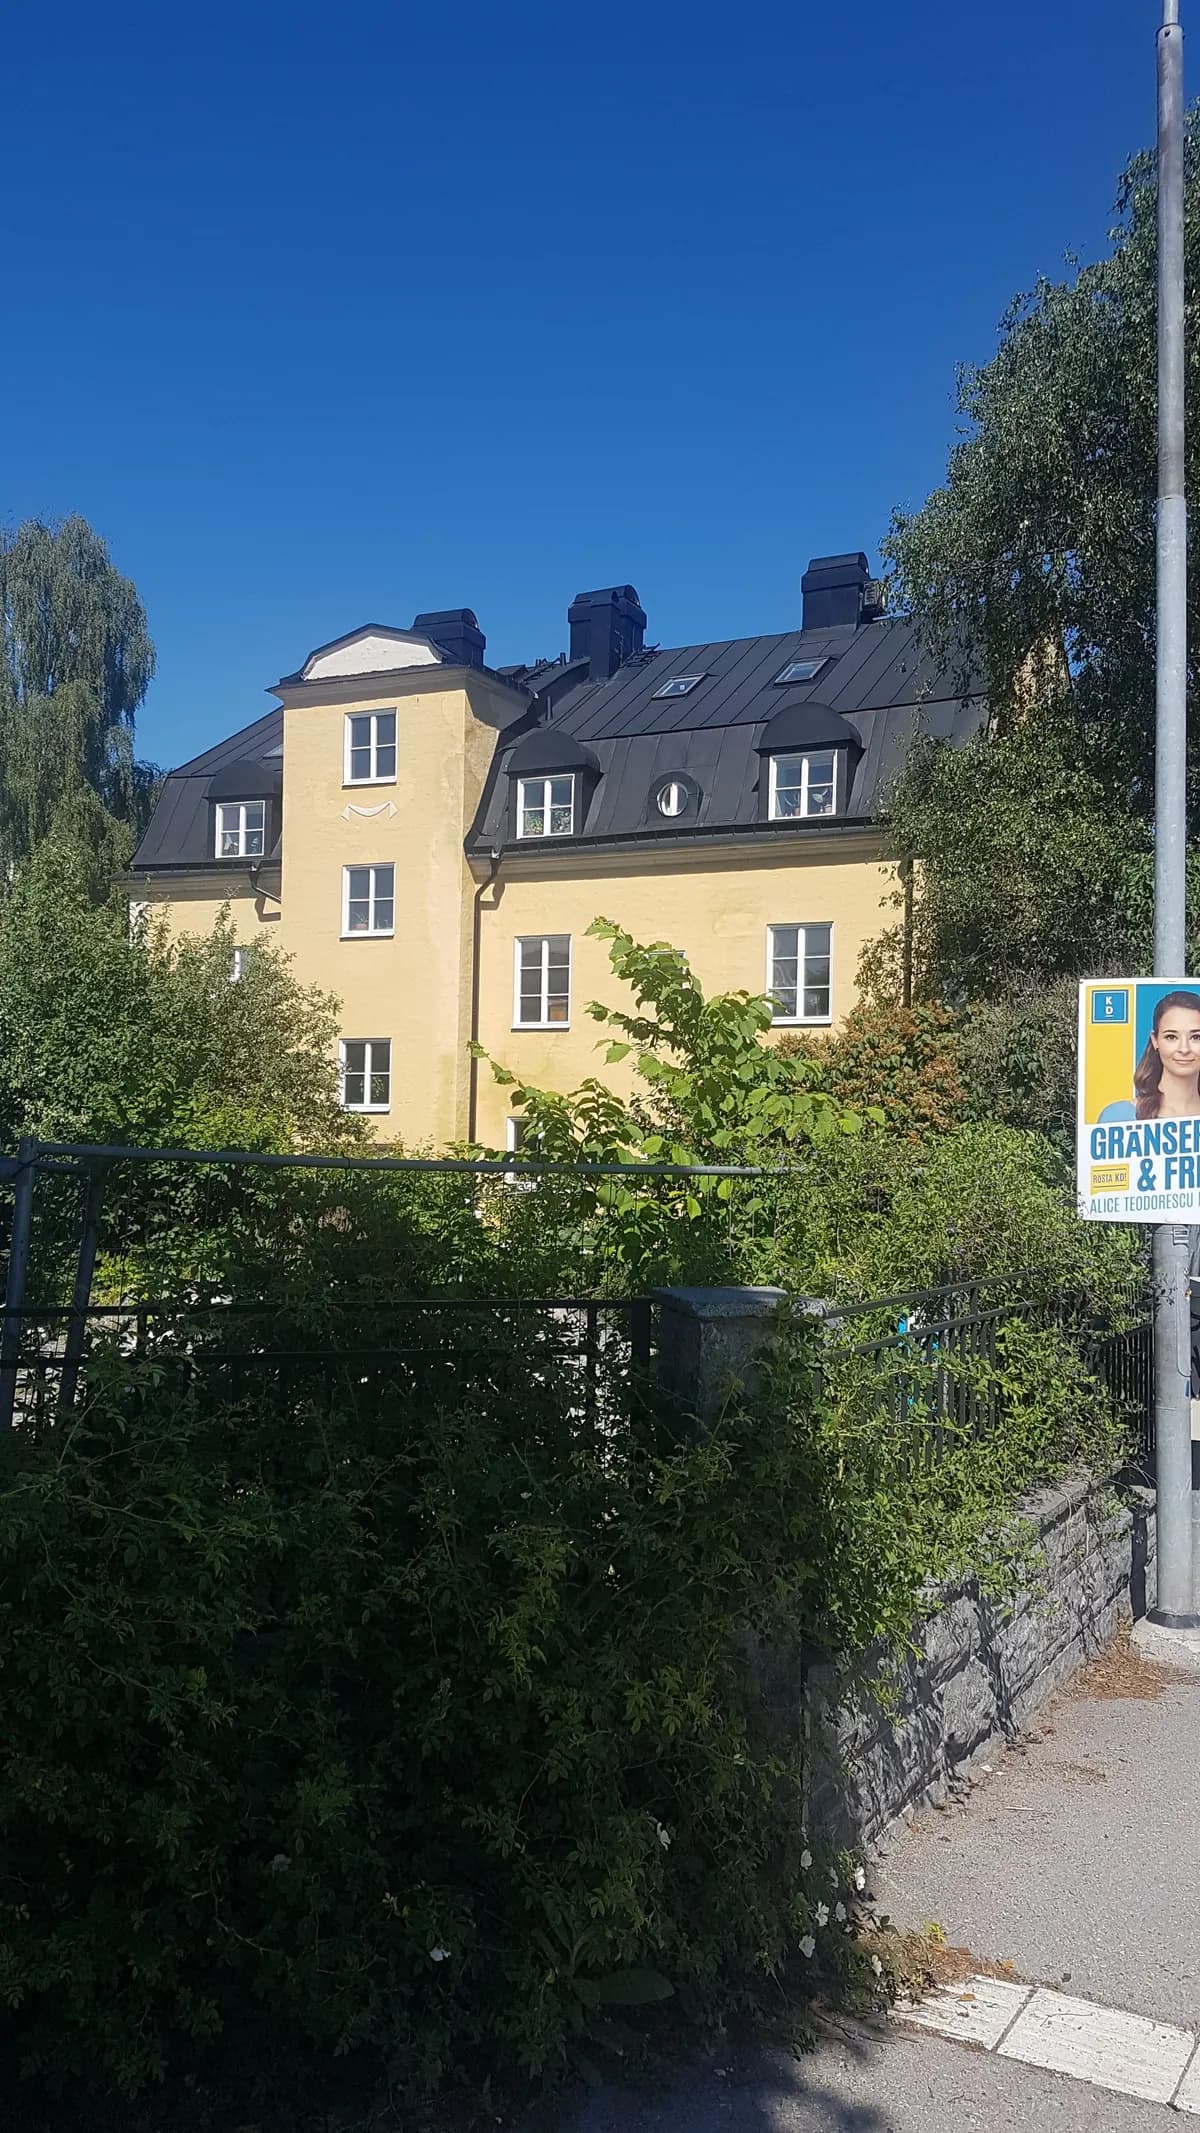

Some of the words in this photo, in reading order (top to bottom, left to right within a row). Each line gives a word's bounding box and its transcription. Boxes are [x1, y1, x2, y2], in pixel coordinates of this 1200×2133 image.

[1137, 1158, 1157, 1192] &
[1090, 1197, 1120, 1215] ALICE
[1124, 1191, 1193, 1212] TEODORESCU
